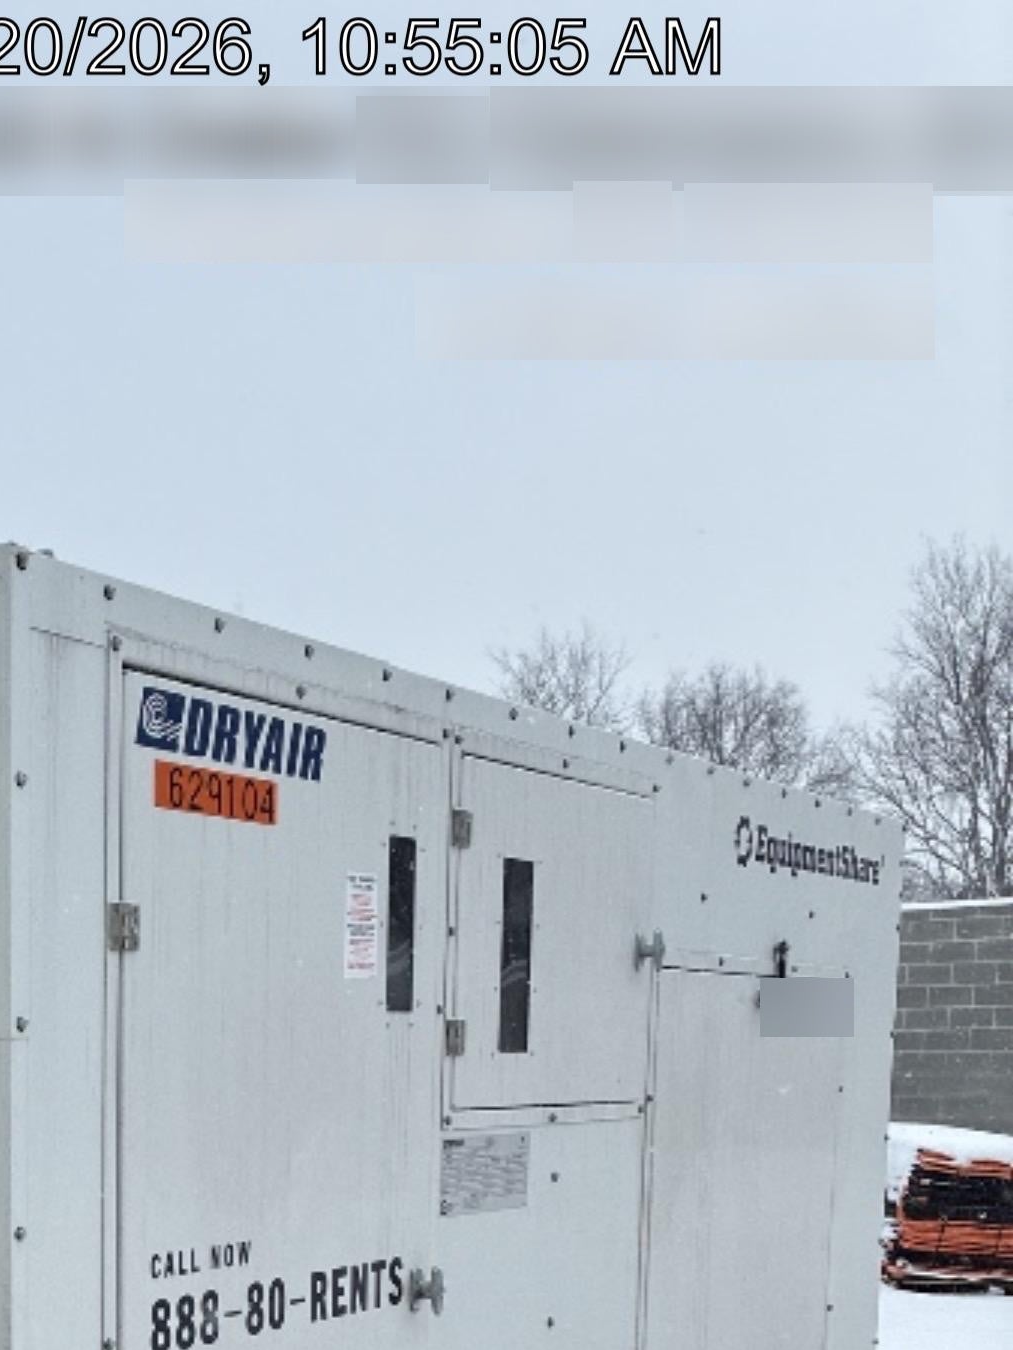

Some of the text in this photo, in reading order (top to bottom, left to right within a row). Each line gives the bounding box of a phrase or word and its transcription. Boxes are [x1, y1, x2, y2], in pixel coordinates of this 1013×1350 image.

[182, 697, 327, 783] DRYAIR
[168, 766, 276, 824] 629104
[754, 824, 880, 886] EquipmentShare
[150, 1240, 252, 1279] CALL NOW
